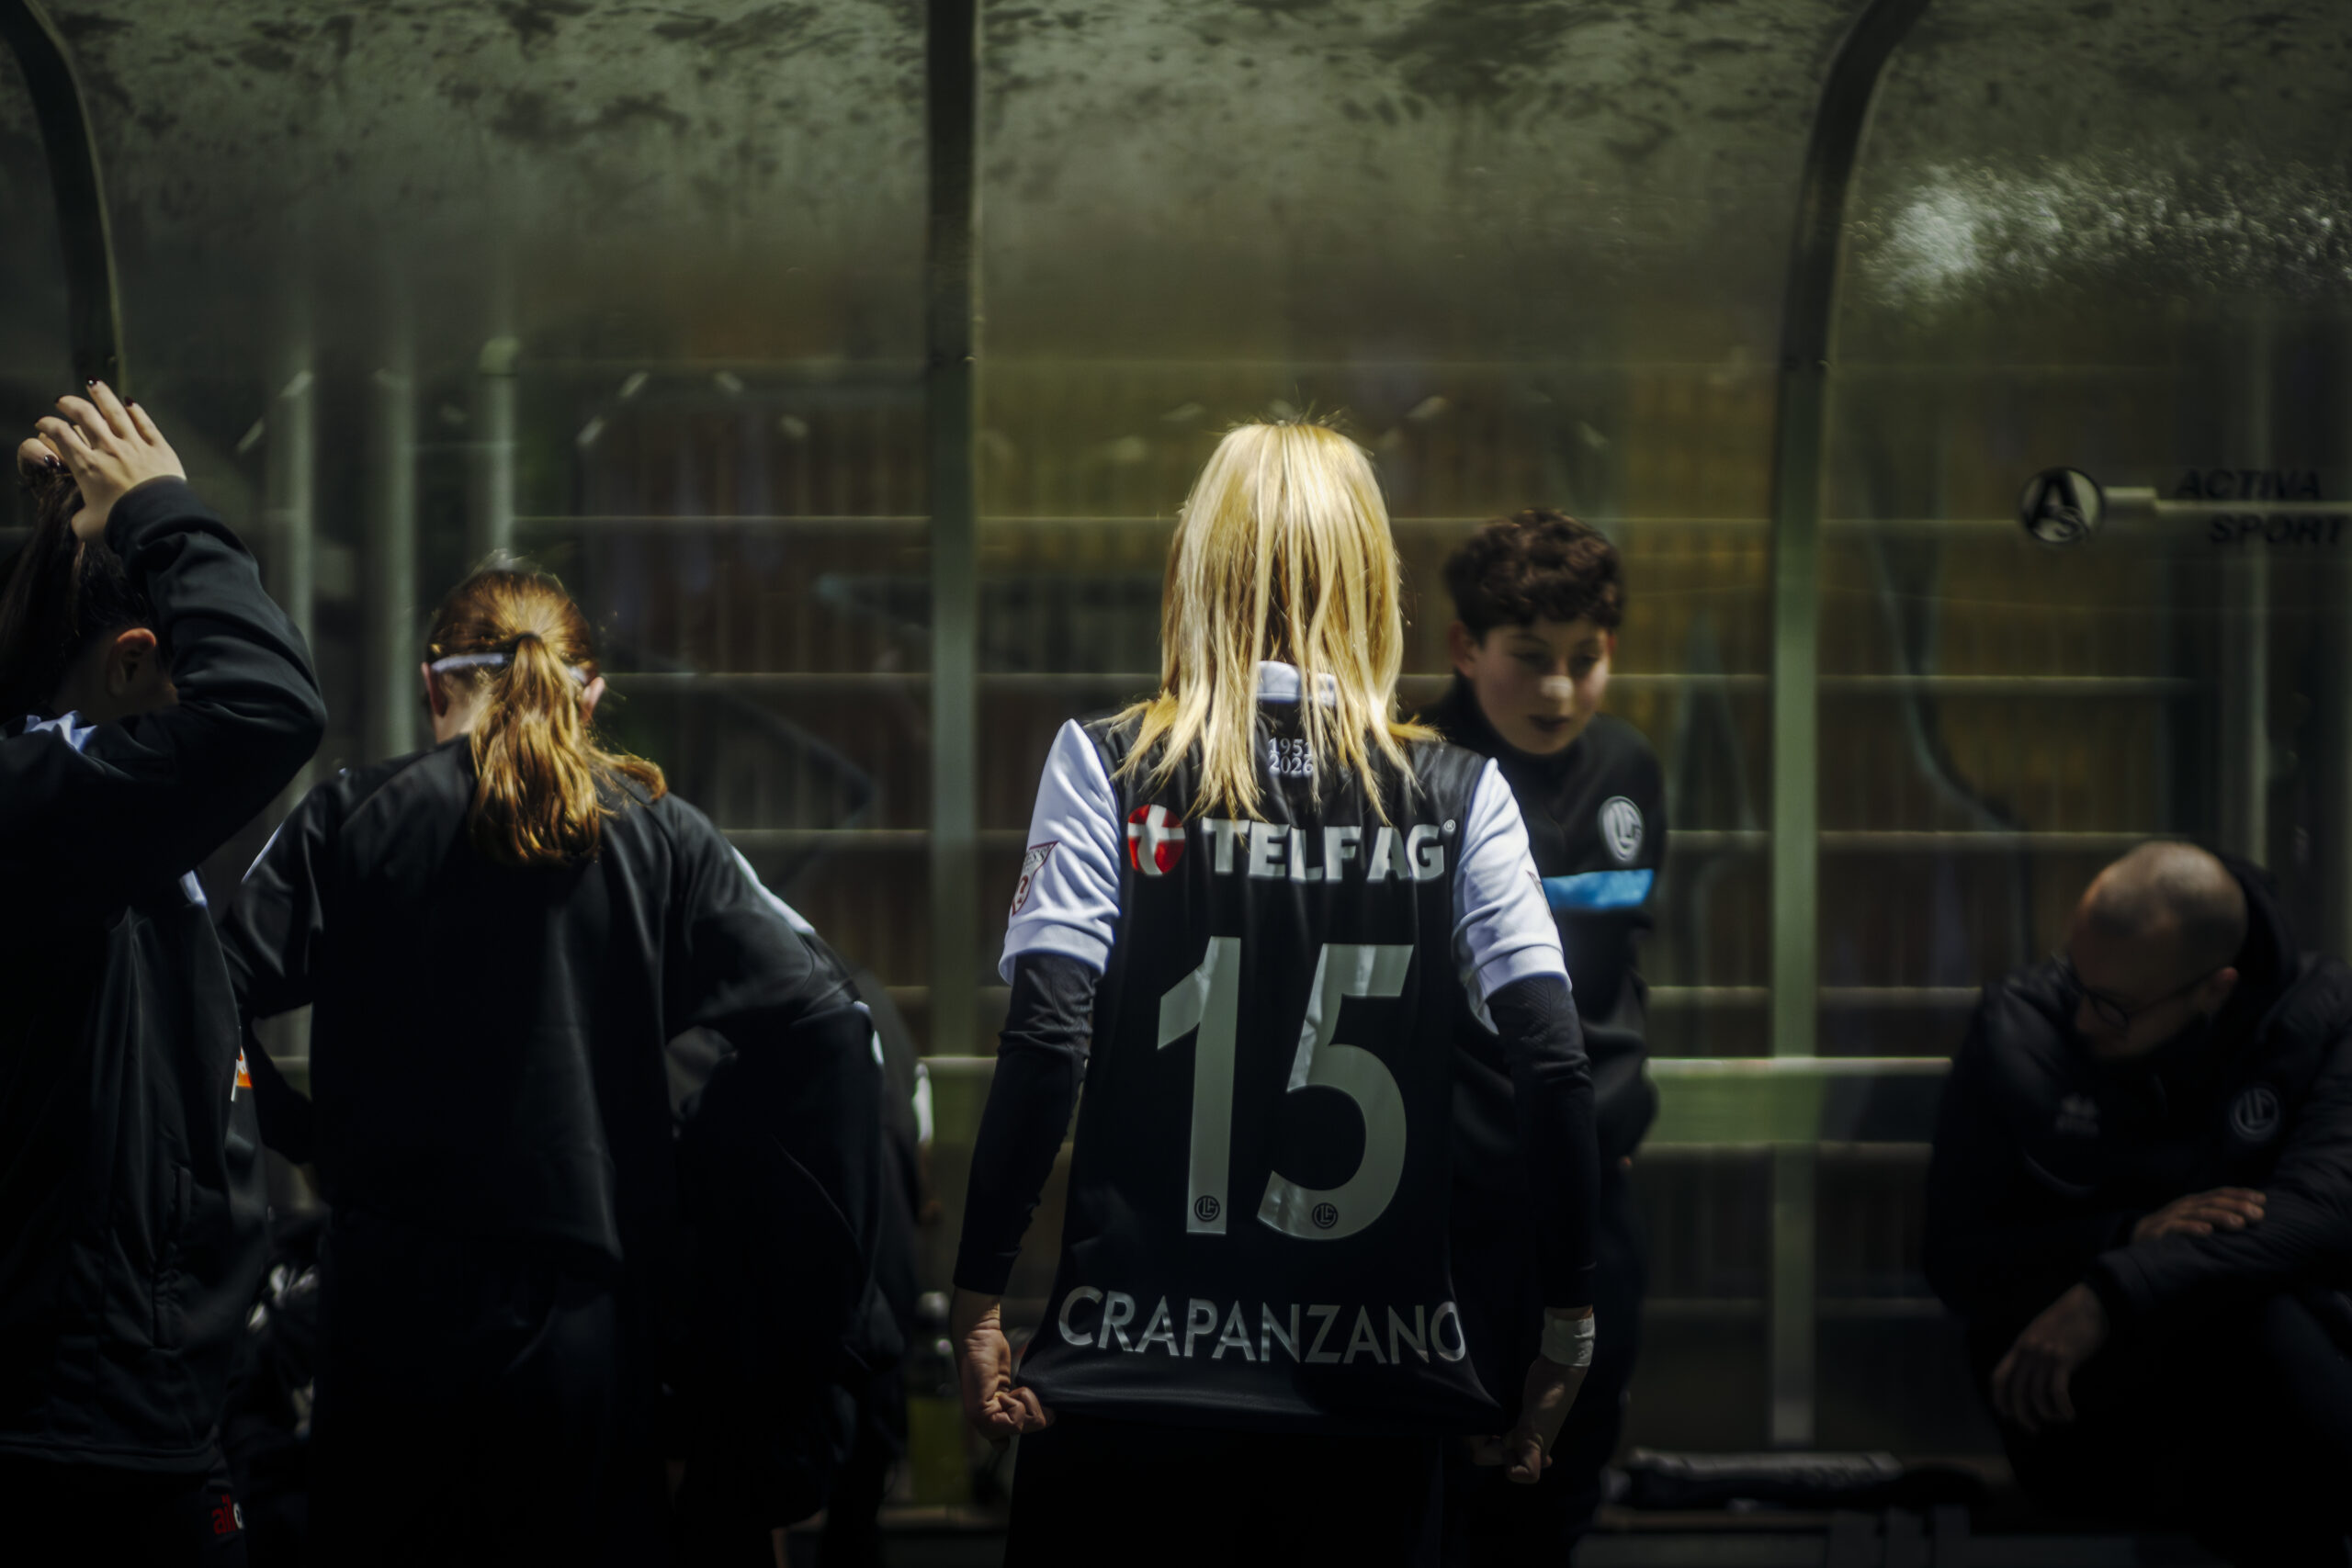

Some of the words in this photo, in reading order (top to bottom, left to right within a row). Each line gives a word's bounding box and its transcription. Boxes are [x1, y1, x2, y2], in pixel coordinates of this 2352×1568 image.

[2174, 469, 2322, 500] ACTIVA
[2208, 514, 2350, 544] SPORT
[1268, 753, 1315, 777] 2026
[1157, 935, 1415, 1240] 15
[1057, 1286, 1466, 1364] CRAPANZANO
